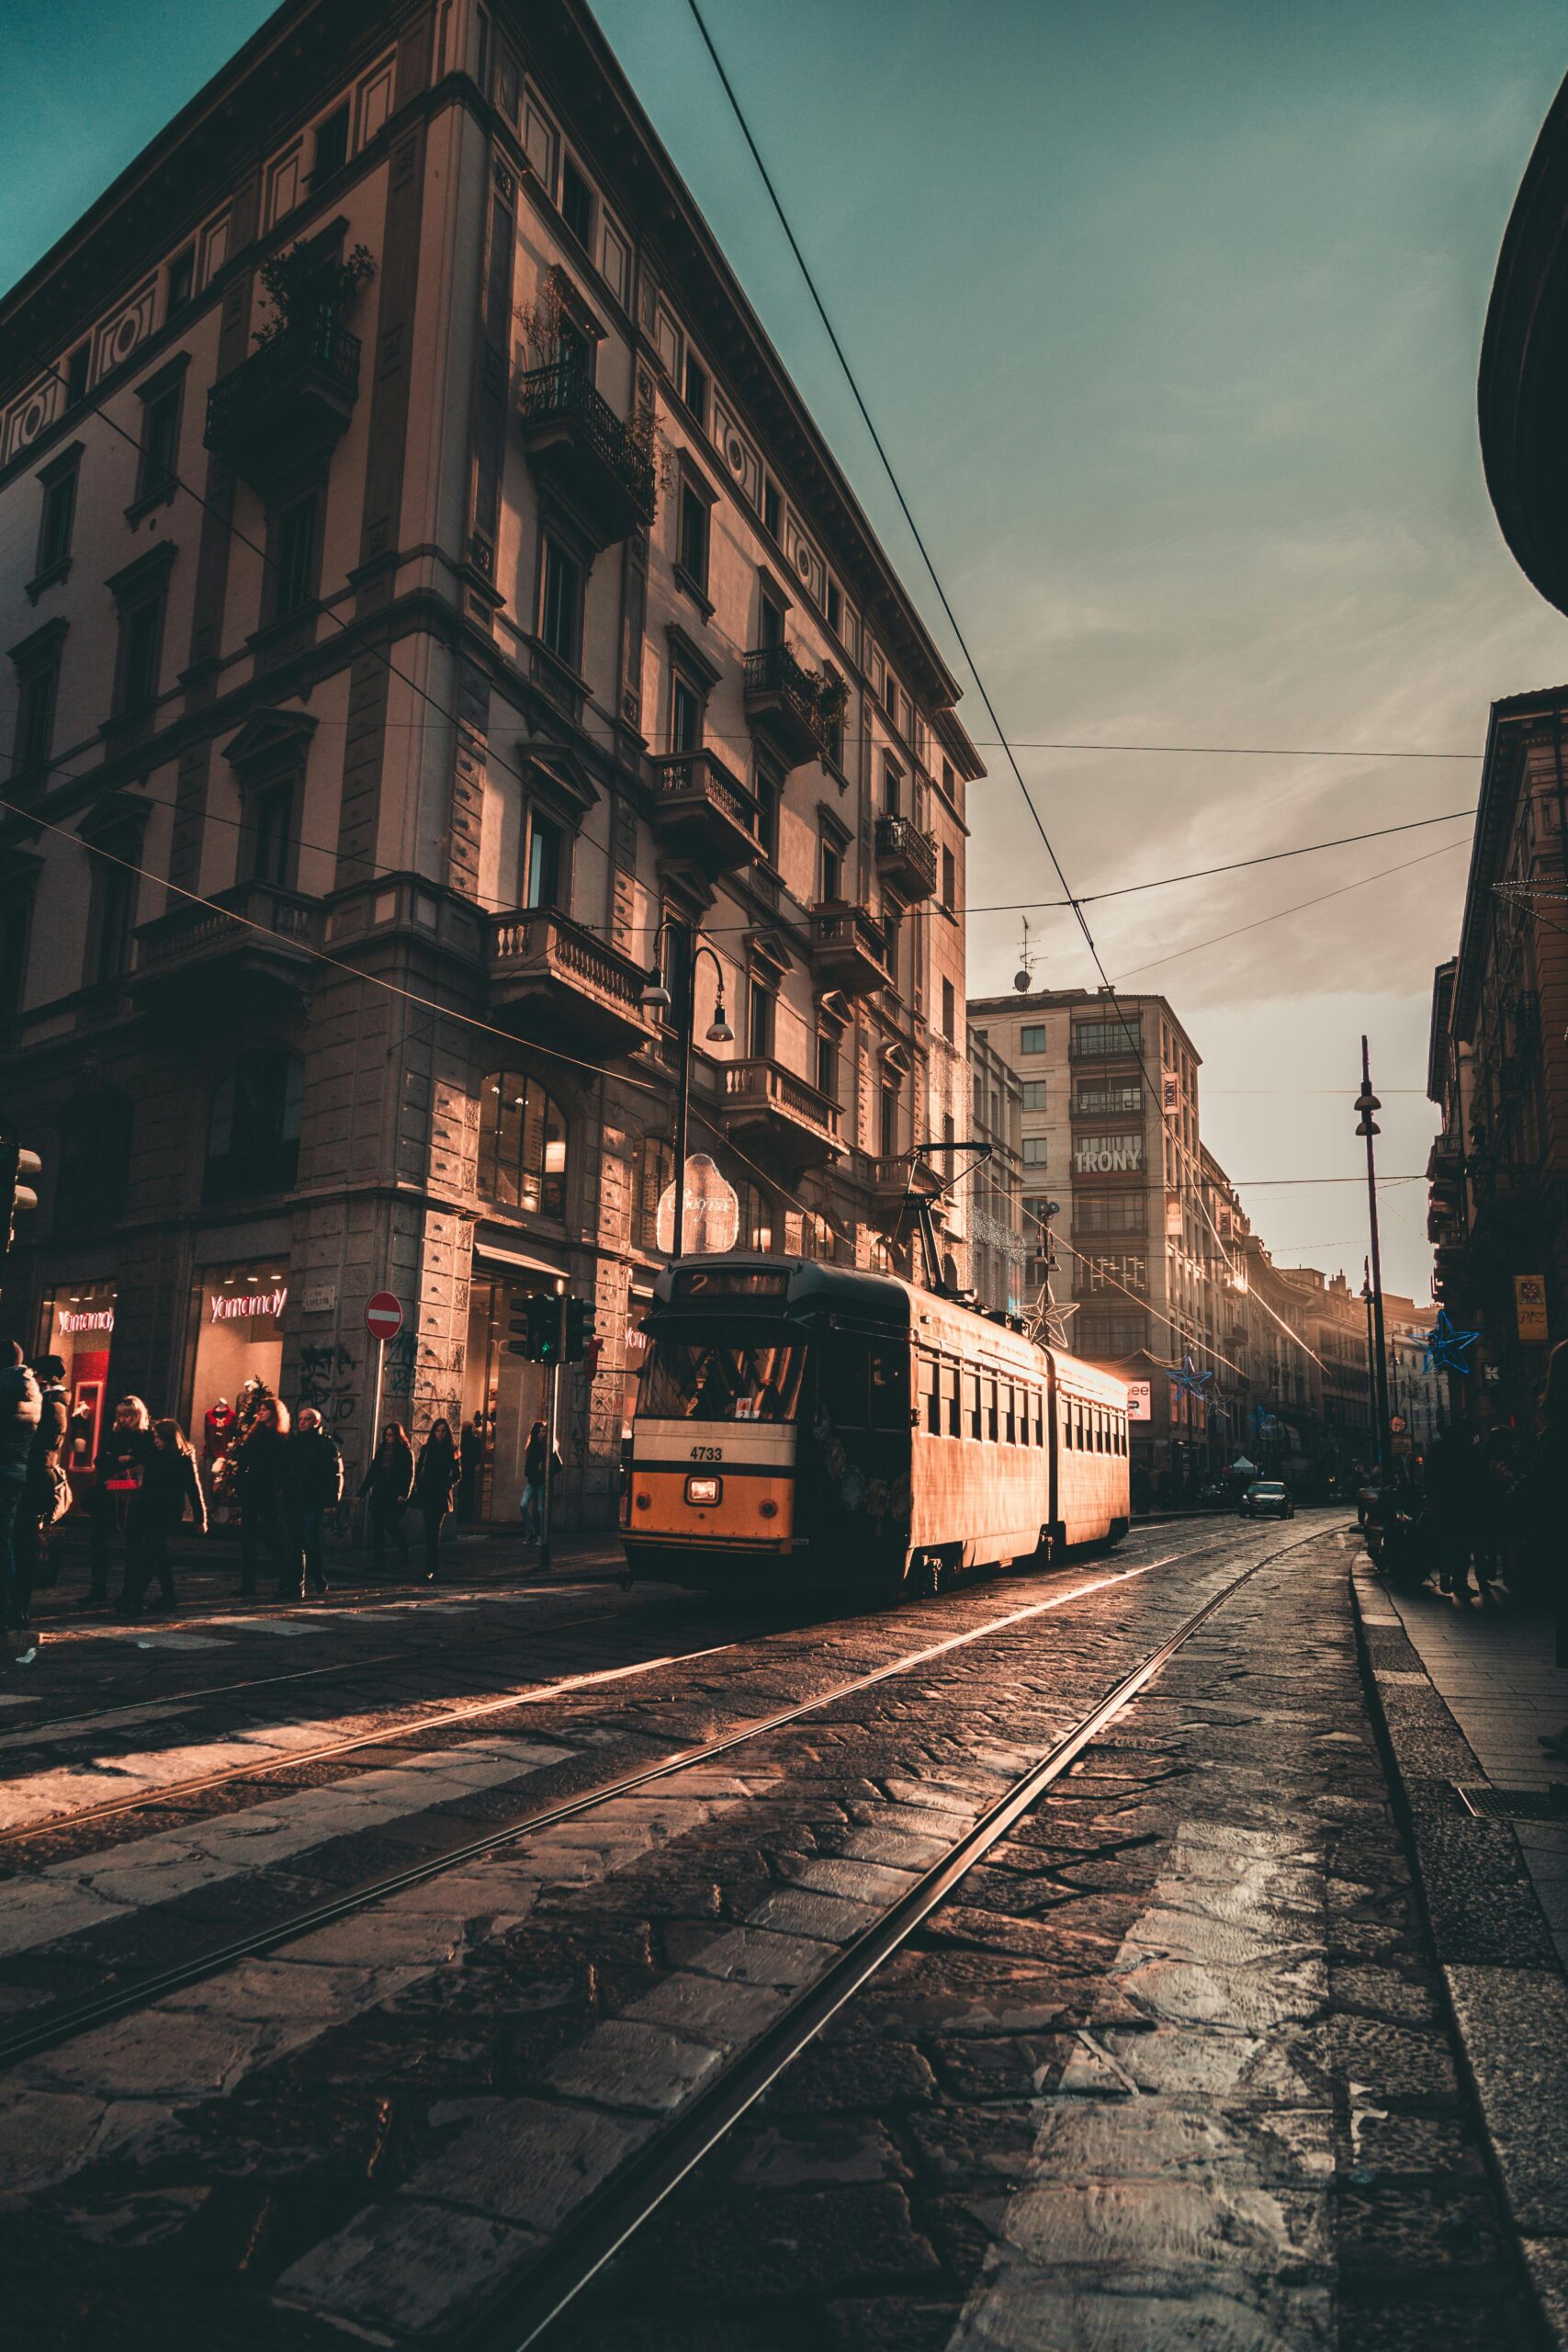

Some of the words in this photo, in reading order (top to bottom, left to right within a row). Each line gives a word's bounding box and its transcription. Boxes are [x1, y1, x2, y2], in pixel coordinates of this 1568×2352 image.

[1165, 1080, 1175, 1108] TRONY
[1074, 1148, 1141, 1173] TRONY
[1220, 1212, 1229, 1235] TRONY
[690, 1273, 710, 1294] 2
[690, 1446, 722, 1461] 4733
